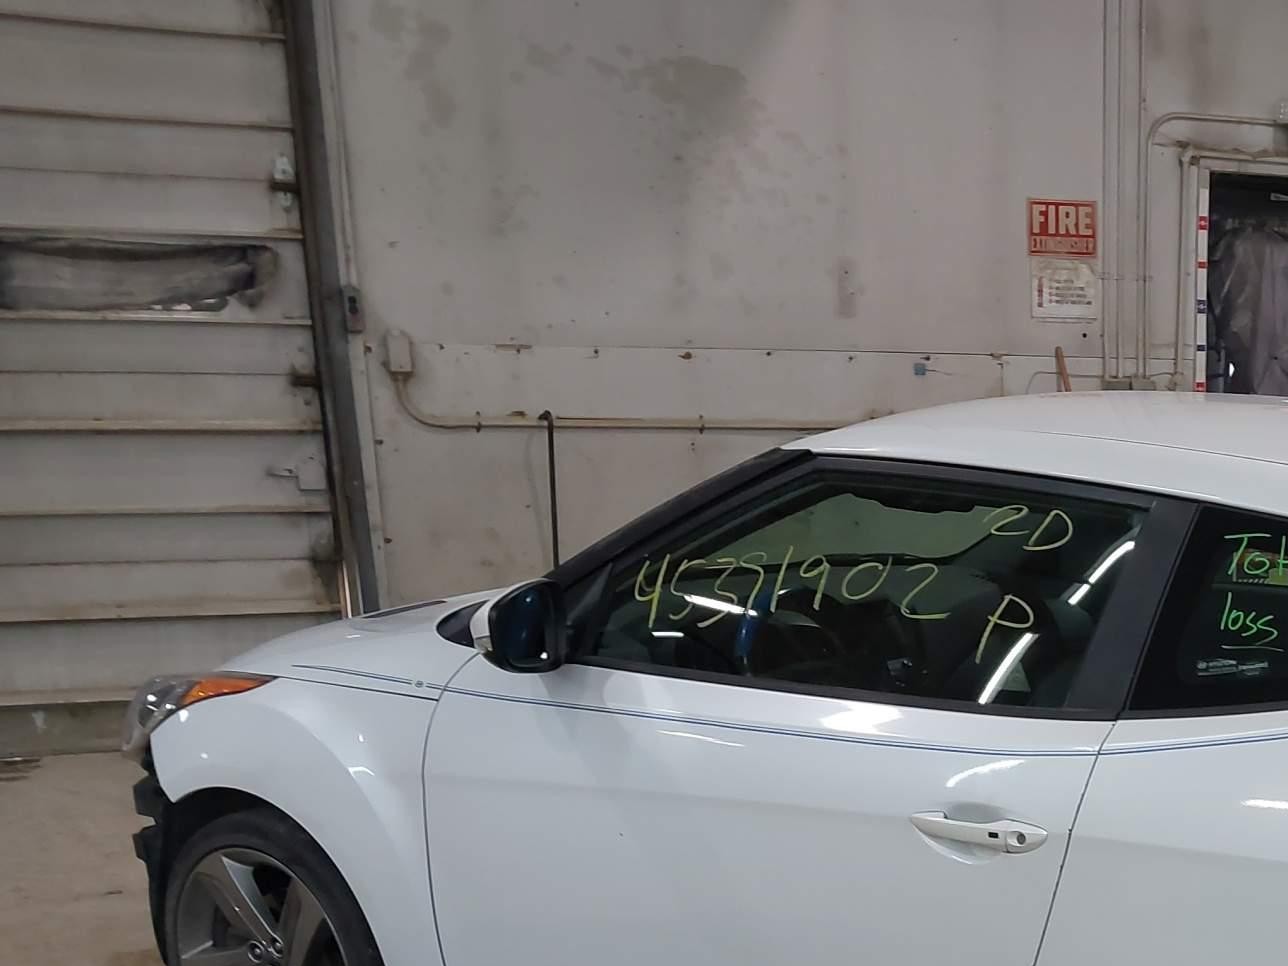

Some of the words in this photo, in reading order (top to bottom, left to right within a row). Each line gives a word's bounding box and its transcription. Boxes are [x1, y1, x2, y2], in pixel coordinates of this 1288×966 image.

[1031, 204, 1093, 236] FIRE
[634, 545, 951, 628] 45391902
[975, 594, 1035, 664] P
[1219, 591, 1279, 646] loss
